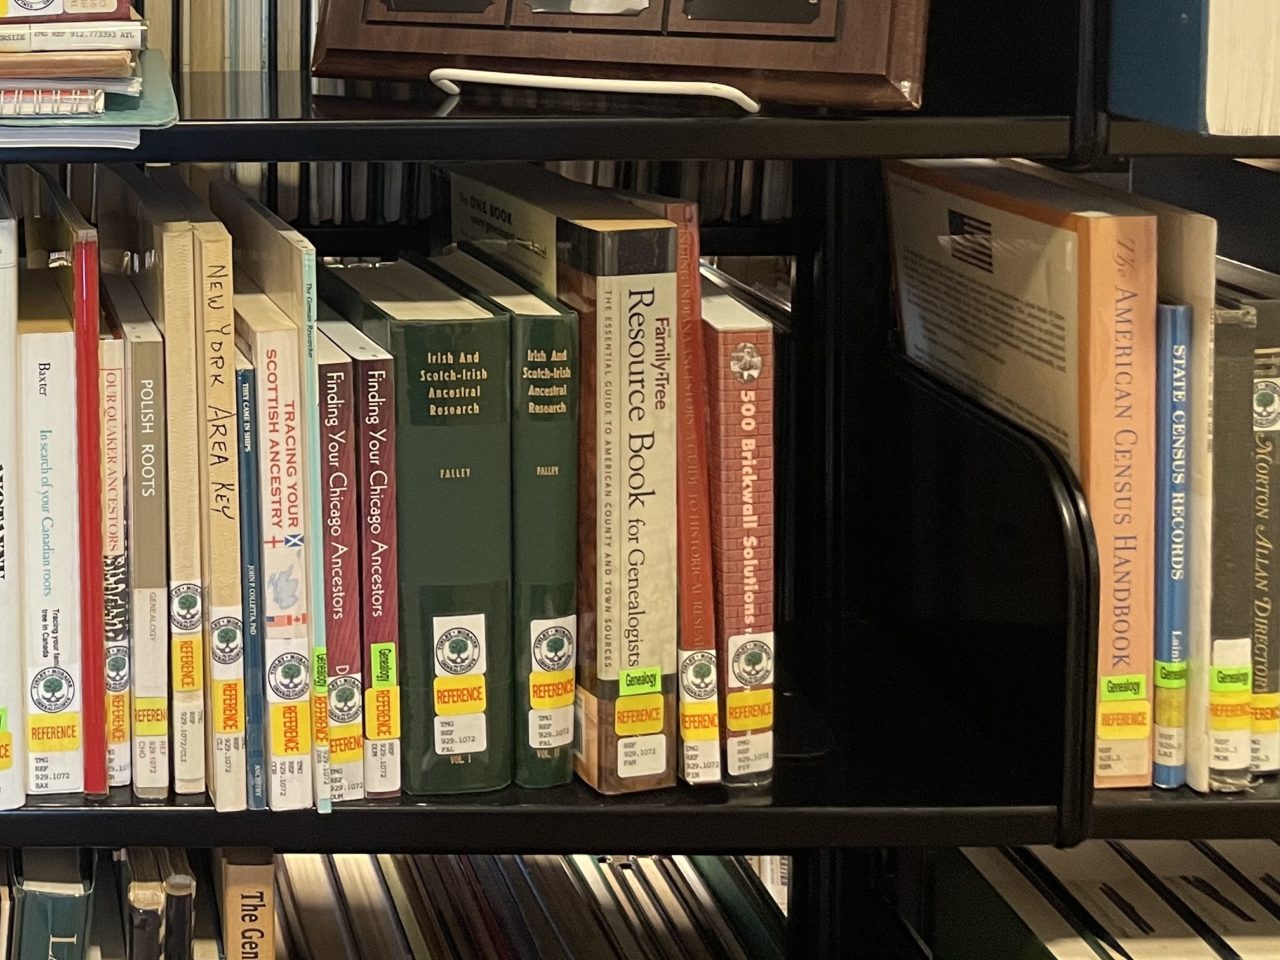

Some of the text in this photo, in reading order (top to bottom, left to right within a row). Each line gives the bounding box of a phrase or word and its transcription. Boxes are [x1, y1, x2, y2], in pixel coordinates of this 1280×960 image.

[206, 264, 229, 310] NEW
[38, 362, 51, 396] Baxter
[205, 323, 231, 387] YORK
[420, 368, 488, 383] Scotch-Irish
[428, 351, 479, 365] Irish And
[428, 386, 481, 399] Ancestral
[430, 403, 480, 416] Research
[140, 379, 155, 497] POLISH ROOTS
[207, 405, 237, 466] AREA
[266, 348, 283, 530] SCOTTISH ANCESTRY
[283, 400, 300, 528] TRACING YOUR
[1172, 344, 1186, 581] STATE CENSUS RECORDS
[367, 369, 388, 618] Finding Your Chicago Ancestors
[627, 288, 655, 668] Resource Book for Genealogists
[740, 389, 759, 624] 500 Brickwall Solutions
[1112, 287, 1138, 668] AMERICAN CENSUS HANDBOOK
[31, 724, 77, 740] REFERENCE
[241, 891, 263, 923] The
